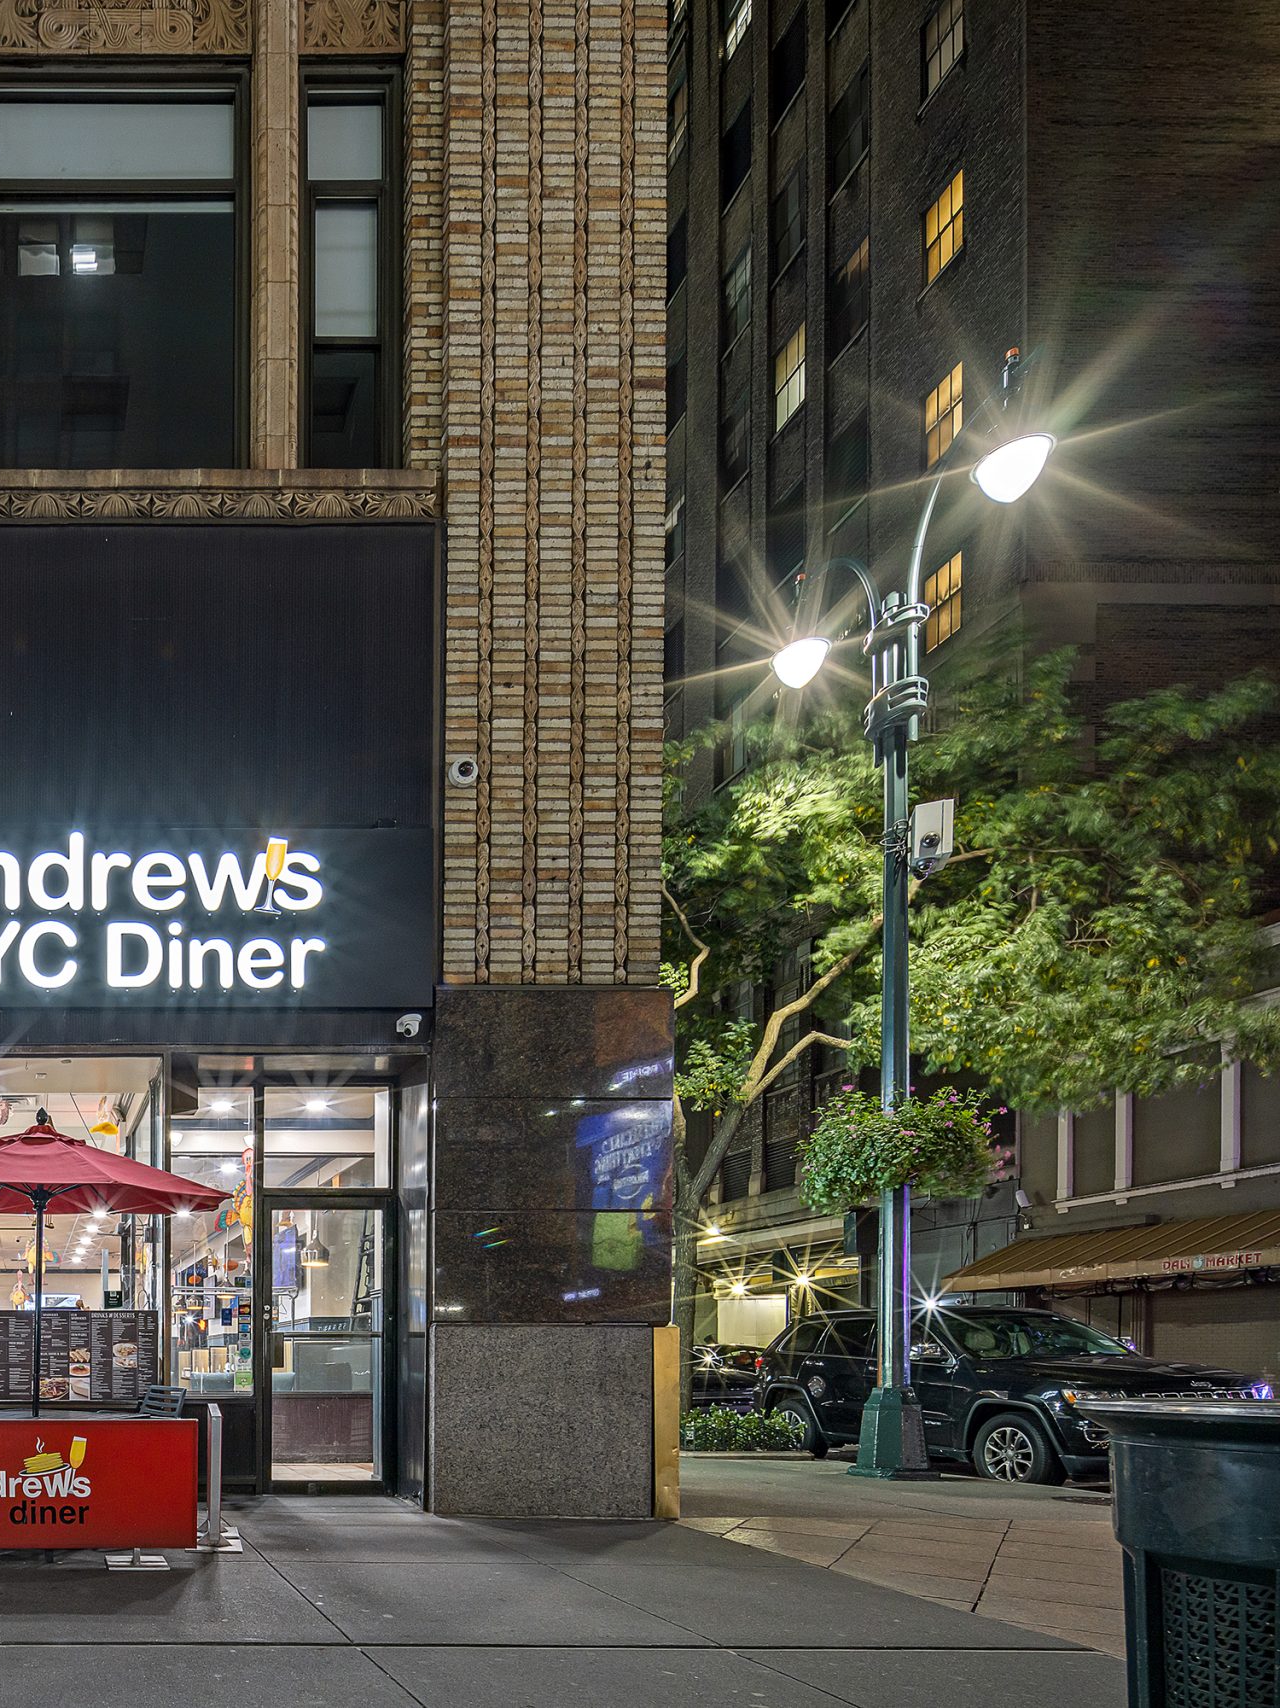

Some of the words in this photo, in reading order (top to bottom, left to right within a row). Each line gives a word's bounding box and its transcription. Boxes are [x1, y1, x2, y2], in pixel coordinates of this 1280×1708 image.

[106, 920, 326, 990] Diner
[1206, 1252, 1262, 1268] MARKET
[9, 1500, 90, 1525] diner
